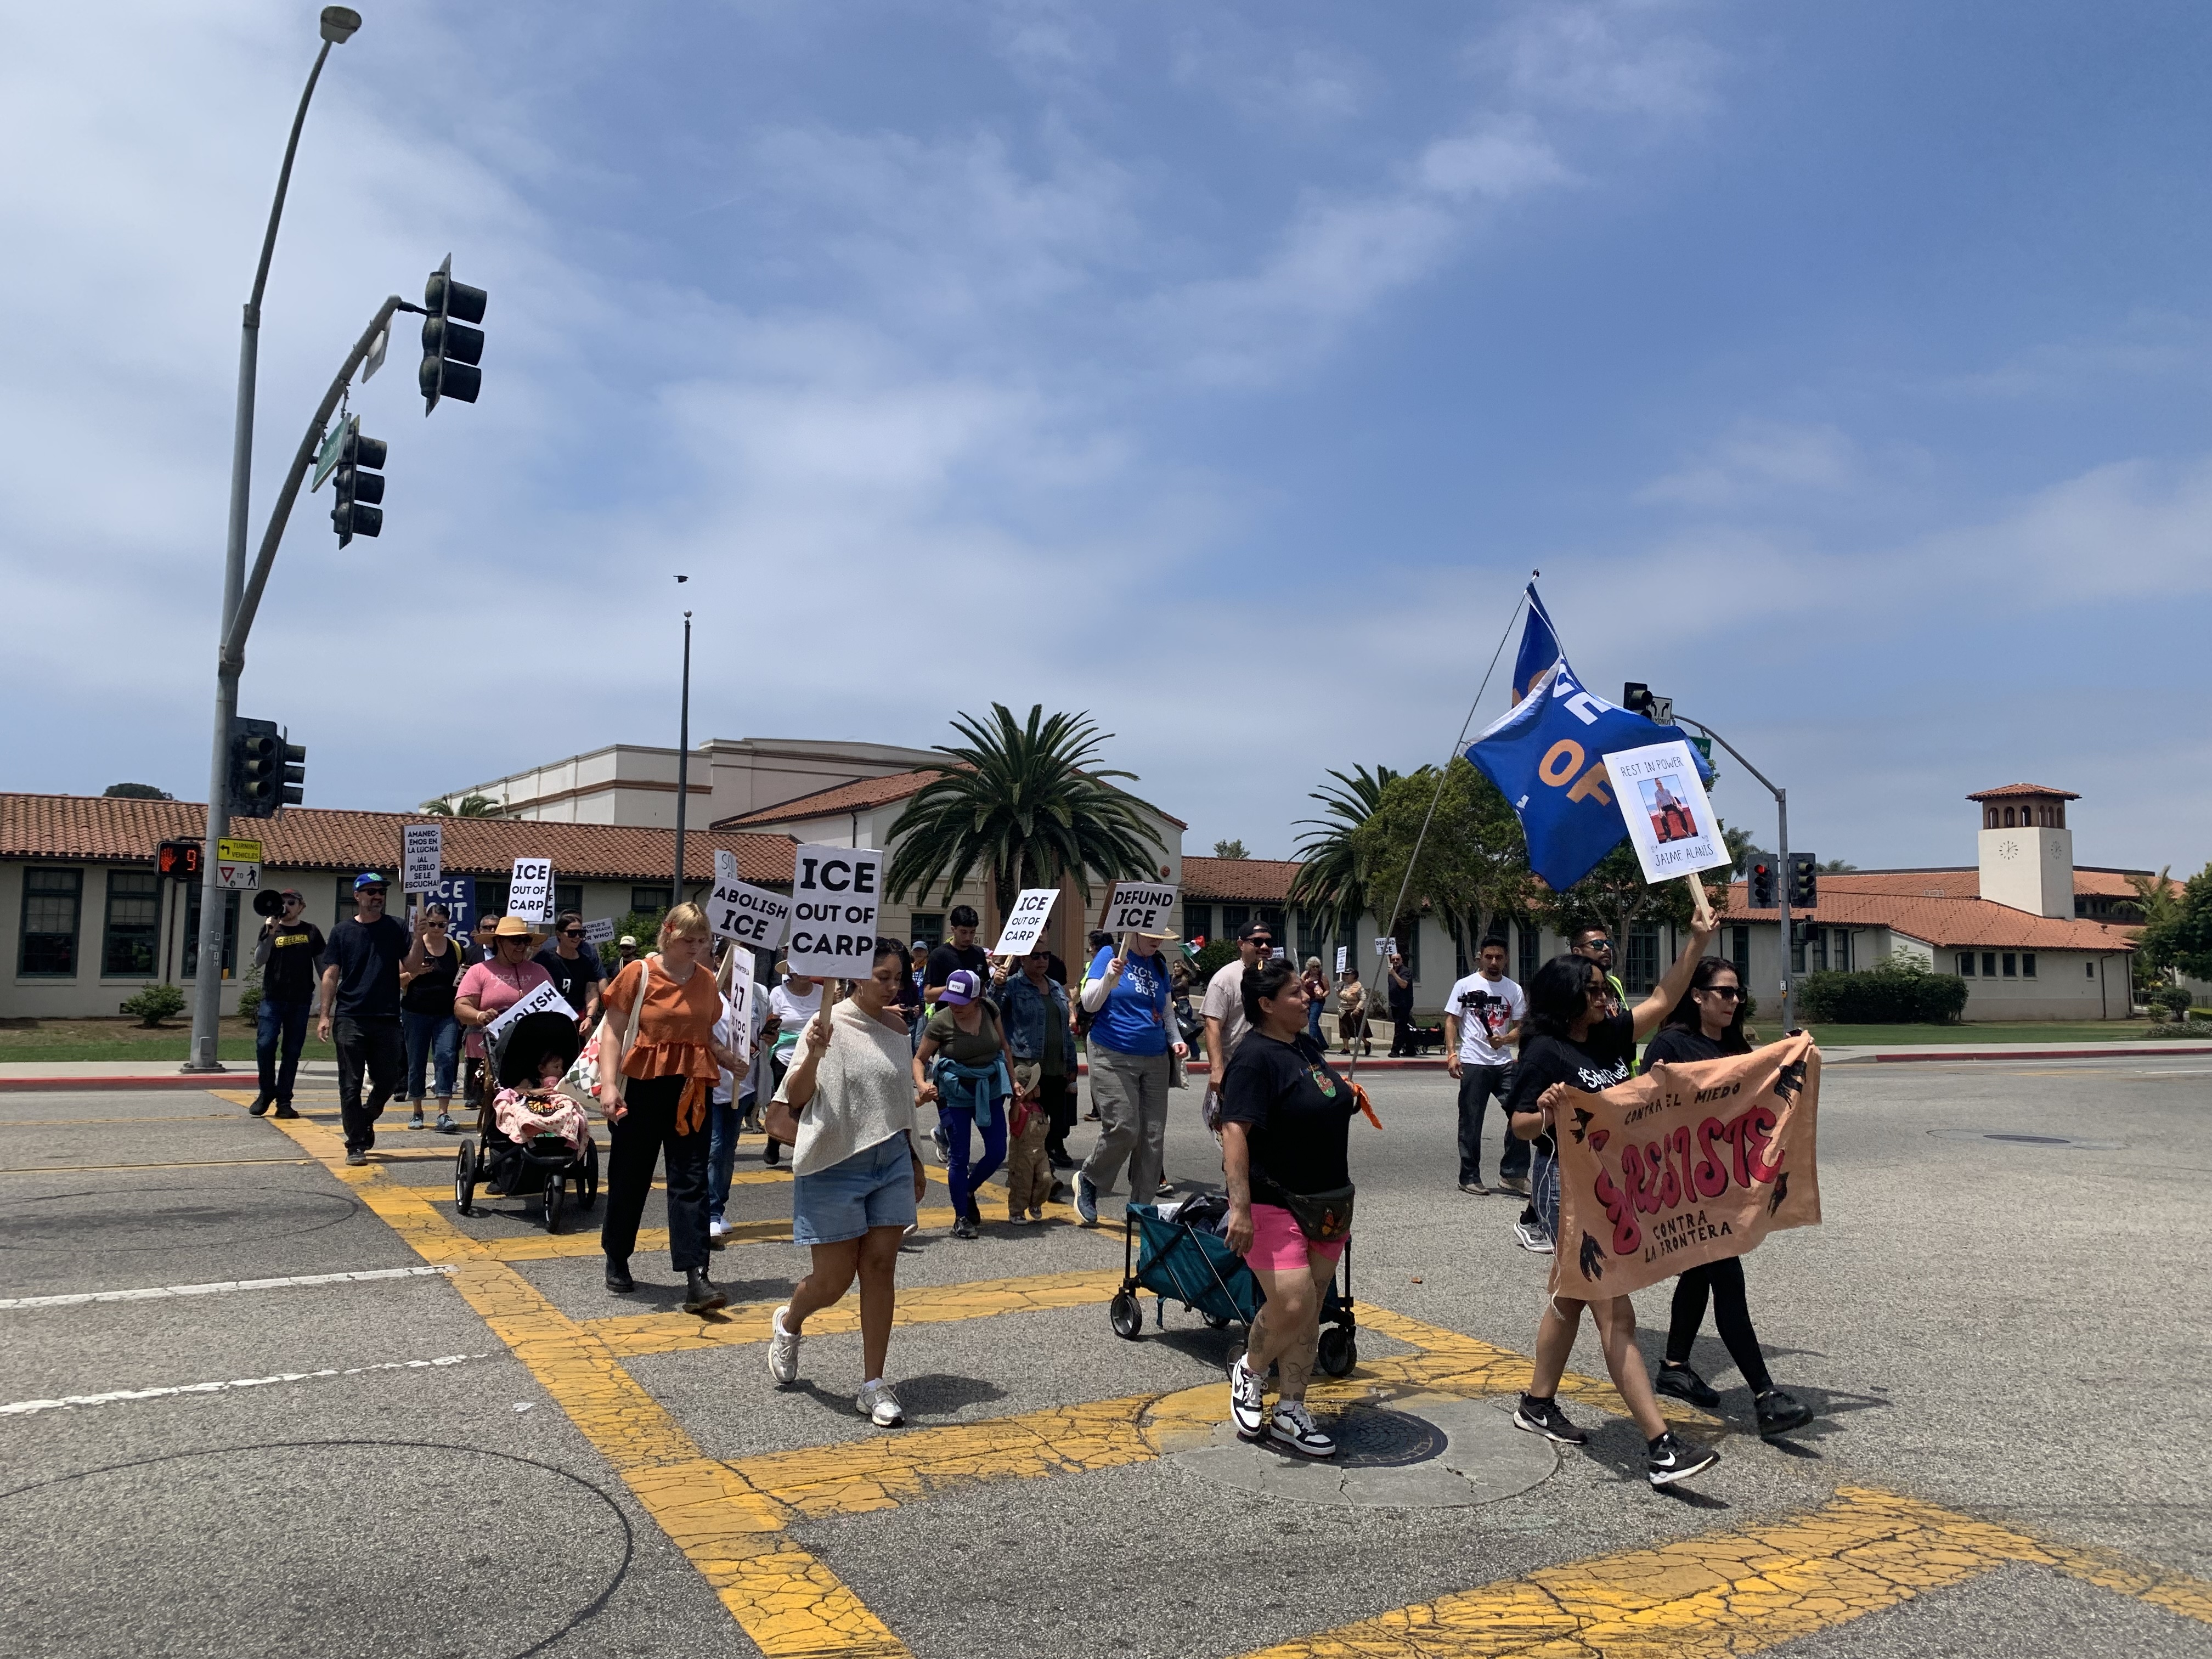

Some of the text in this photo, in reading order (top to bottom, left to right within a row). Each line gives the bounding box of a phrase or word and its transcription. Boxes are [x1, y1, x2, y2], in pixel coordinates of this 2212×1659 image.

[1700, 744, 1708, 753] Ave
[1620, 757, 1684, 777] REST IN POWER
[187, 849, 196, 871] 9
[1655, 850, 1683, 866] JAIME
[410, 864, 435, 872] PUEBLO
[515, 865, 547, 879] ICE
[800, 859, 875, 893] ICE
[405, 879, 439, 889] ESCUCHA!
[512, 886, 546, 895] OUT OF
[510, 900, 544, 910] CARP
[714, 886, 788, 919] ABOLISH
[1018, 896, 1049, 911] ICE
[1114, 890, 1173, 907] DEFUND
[795, 903, 874, 923] OUT OF
[1012, 917, 1041, 926] OUT OF
[1116, 909, 1156, 928] ICE
[720, 909, 769, 941] ICE
[792, 932, 873, 956] CARP
[1005, 930, 1034, 941] CARP
[733, 983, 744, 1012] 27
[736, 1019, 746, 1034] TOO
[1624, 1082, 1741, 1125] CONTRA EL MIEDO
[1653, 1210, 1708, 1240] CONTRA
[1645, 1221, 1733, 1263] LA FRONTERA
